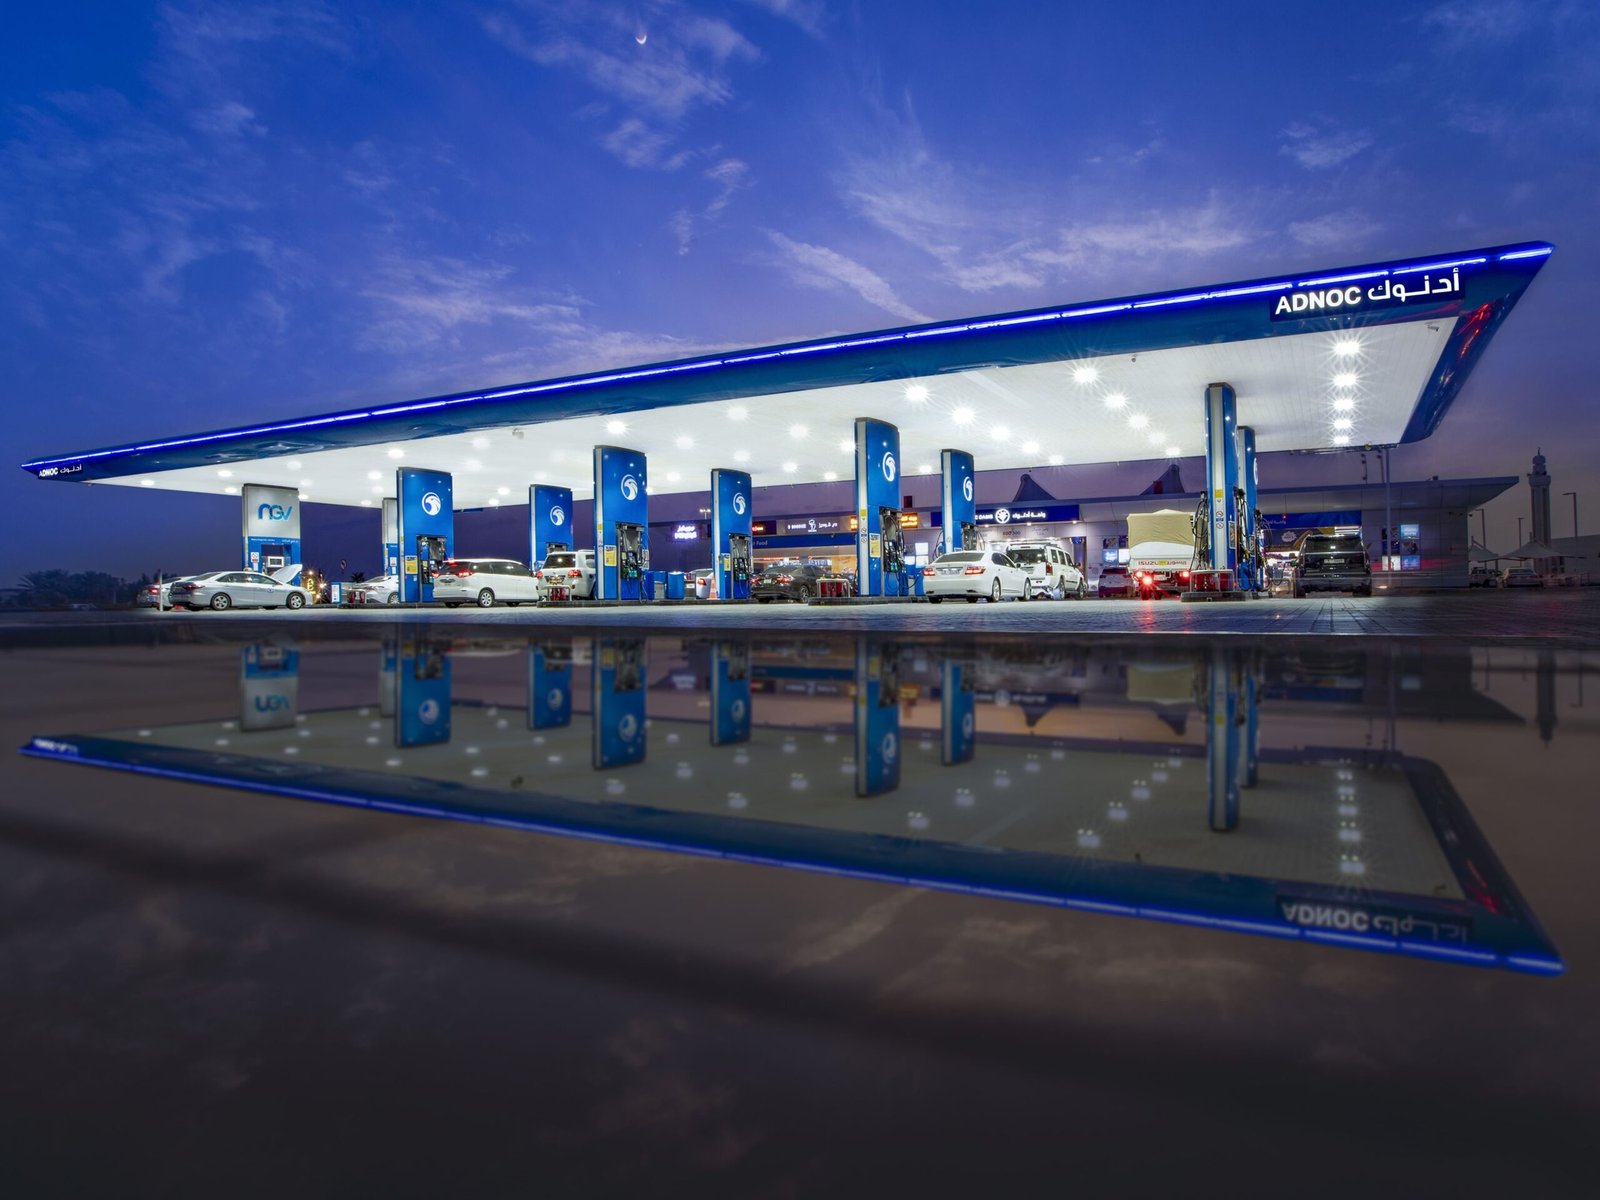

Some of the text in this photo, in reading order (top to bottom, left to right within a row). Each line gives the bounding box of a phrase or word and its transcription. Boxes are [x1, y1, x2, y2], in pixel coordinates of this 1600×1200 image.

[1367, 267, 1460, 302] أدنوك
[1275, 287, 1362, 315] ADNOC
[39, 467, 58, 477] ADNOC
